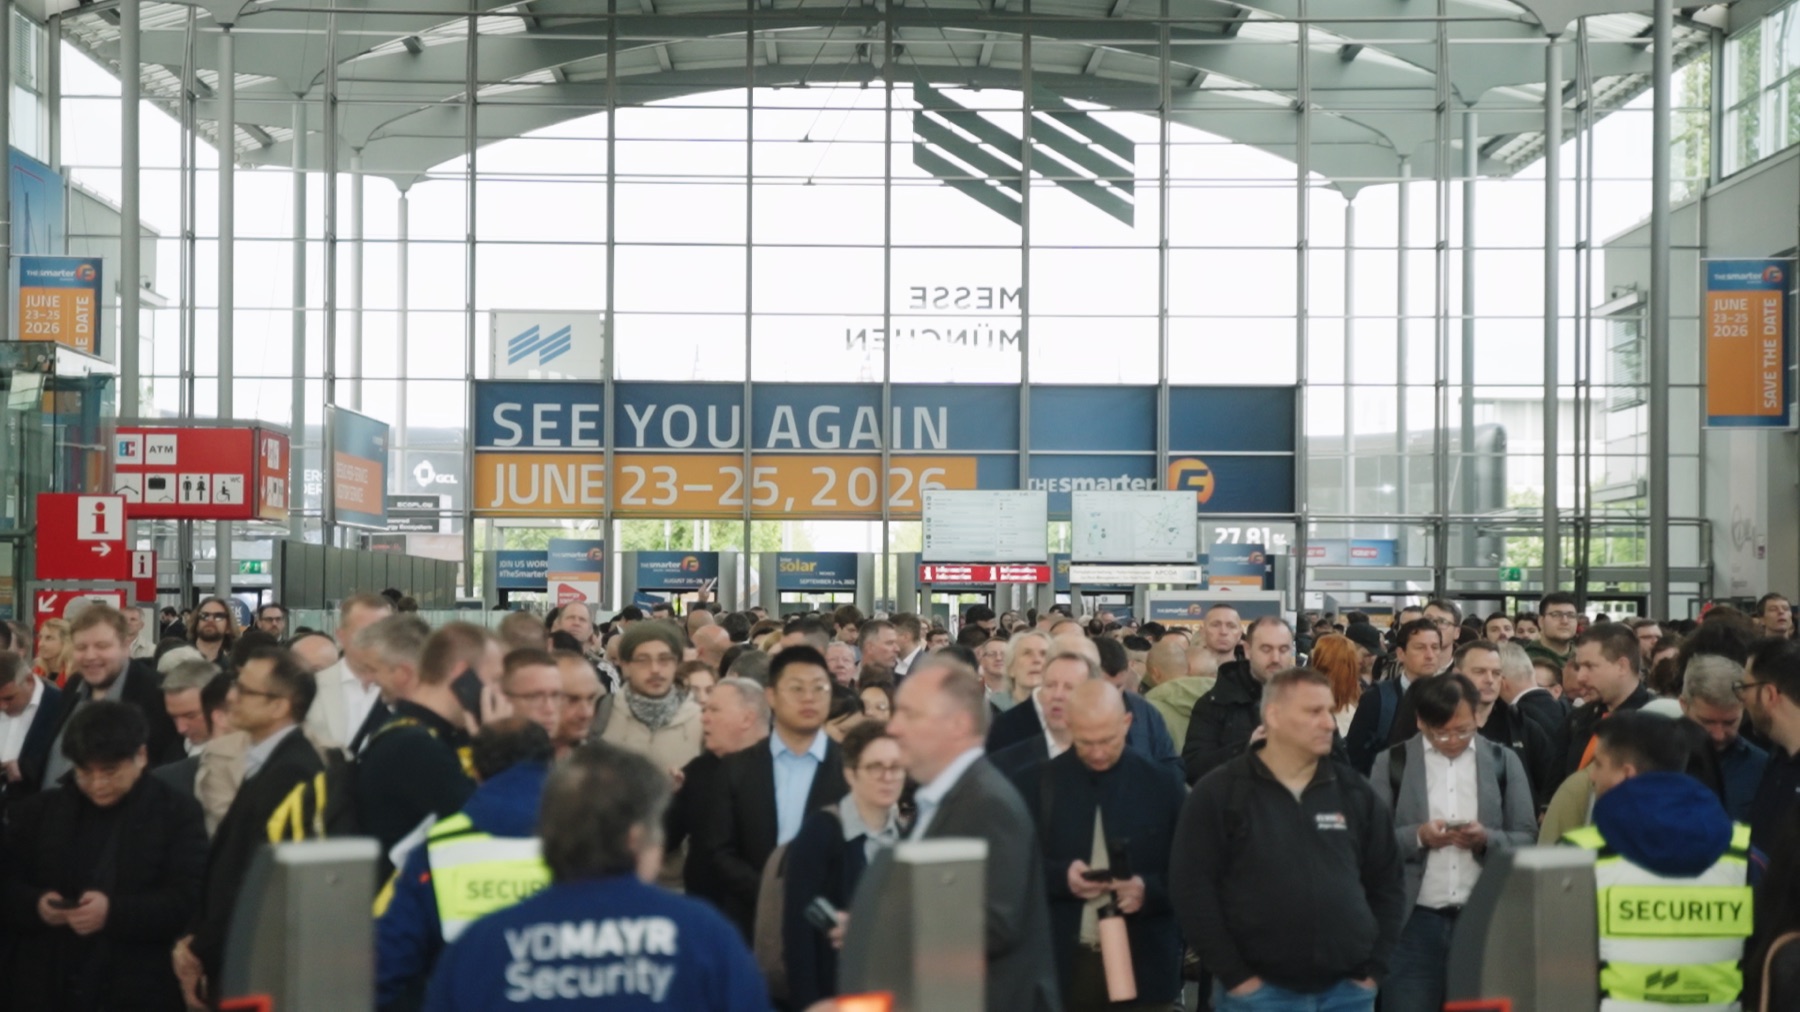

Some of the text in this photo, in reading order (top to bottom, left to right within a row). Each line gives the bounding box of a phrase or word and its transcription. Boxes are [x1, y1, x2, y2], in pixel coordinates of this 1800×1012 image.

[40, 267, 76, 278] smarter
[1727, 271, 1762, 281] smarter
[25, 295, 61, 308] JUNE
[1713, 299, 1749, 312] JUNE
[75, 296, 90, 334] DATE
[25, 322, 61, 335] 2026
[1713, 325, 1749, 337] 2026
[1763, 298, 1778, 408] SAVE THE DATE
[492, 402, 948, 450] SEE YOU AGAIN
[148, 444, 174, 454] ATM
[229, 476, 242, 484] WC
[435, 473, 458, 484] GCL
[1028, 477, 1058, 492] THE
[1058, 474, 1157, 493] smarter
[490, 463, 605, 508] JUNE
[811, 466, 946, 508] 2026
[650, 560, 681, 569] smarter
[779, 558, 817, 573] solar
[1618, 900, 1744, 922] SECURITY
[504, 956, 675, 1003] Security
